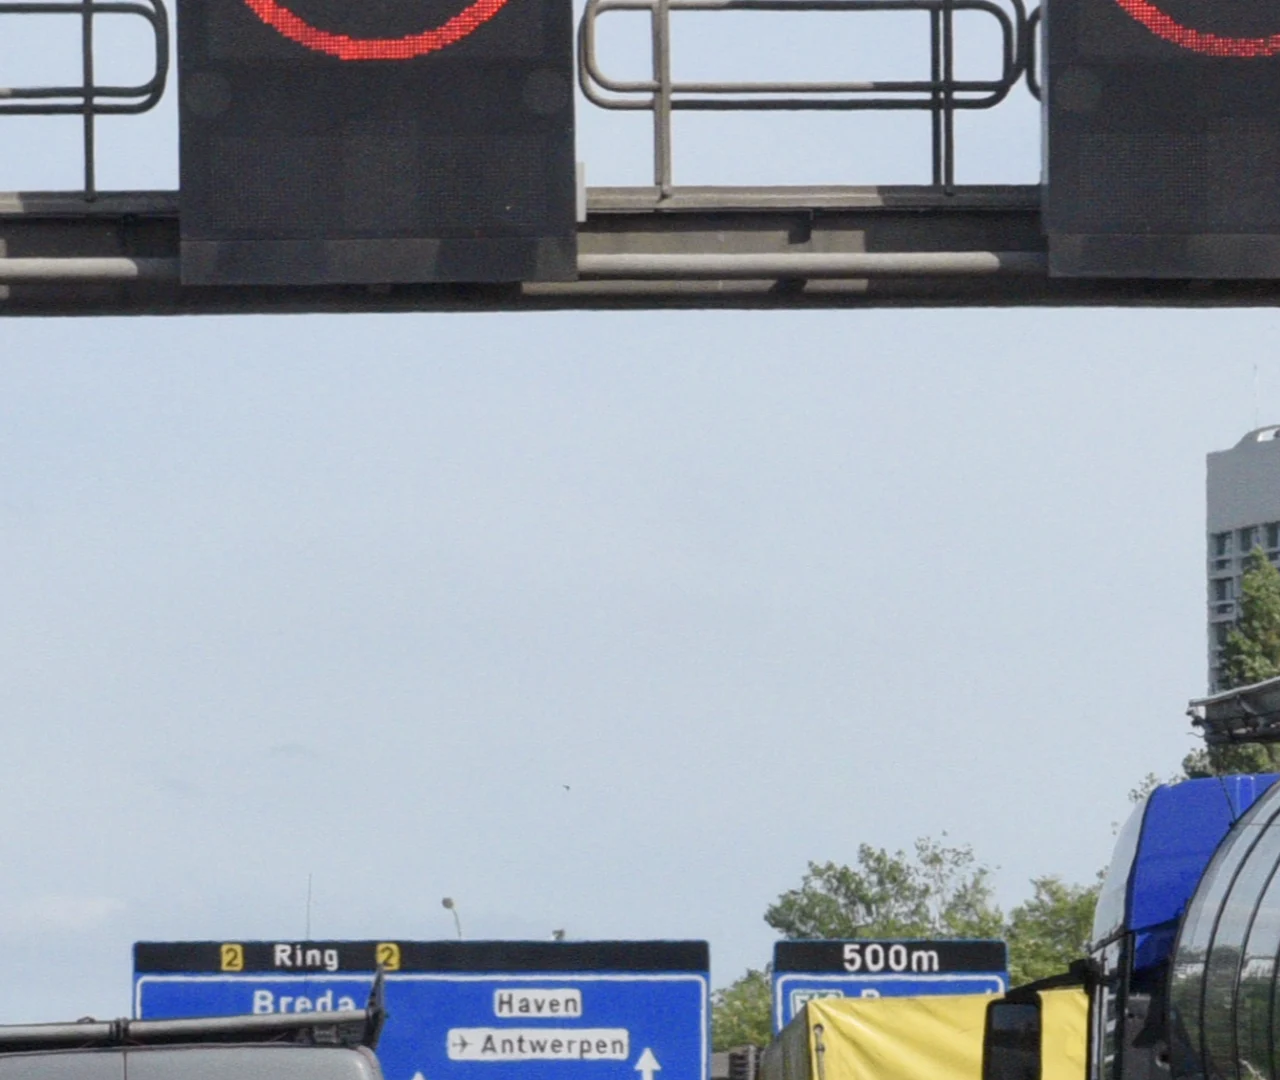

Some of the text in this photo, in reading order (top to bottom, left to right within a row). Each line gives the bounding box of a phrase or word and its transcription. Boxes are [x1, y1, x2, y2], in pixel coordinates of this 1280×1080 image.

[223, 947, 240, 968] 2
[273, 943, 340, 972] Ring
[842, 943, 939, 972] 500m
[252, 988, 357, 1015] Breda
[498, 992, 578, 1014] Haven
[480, 1034, 626, 1059] Antwerpen
